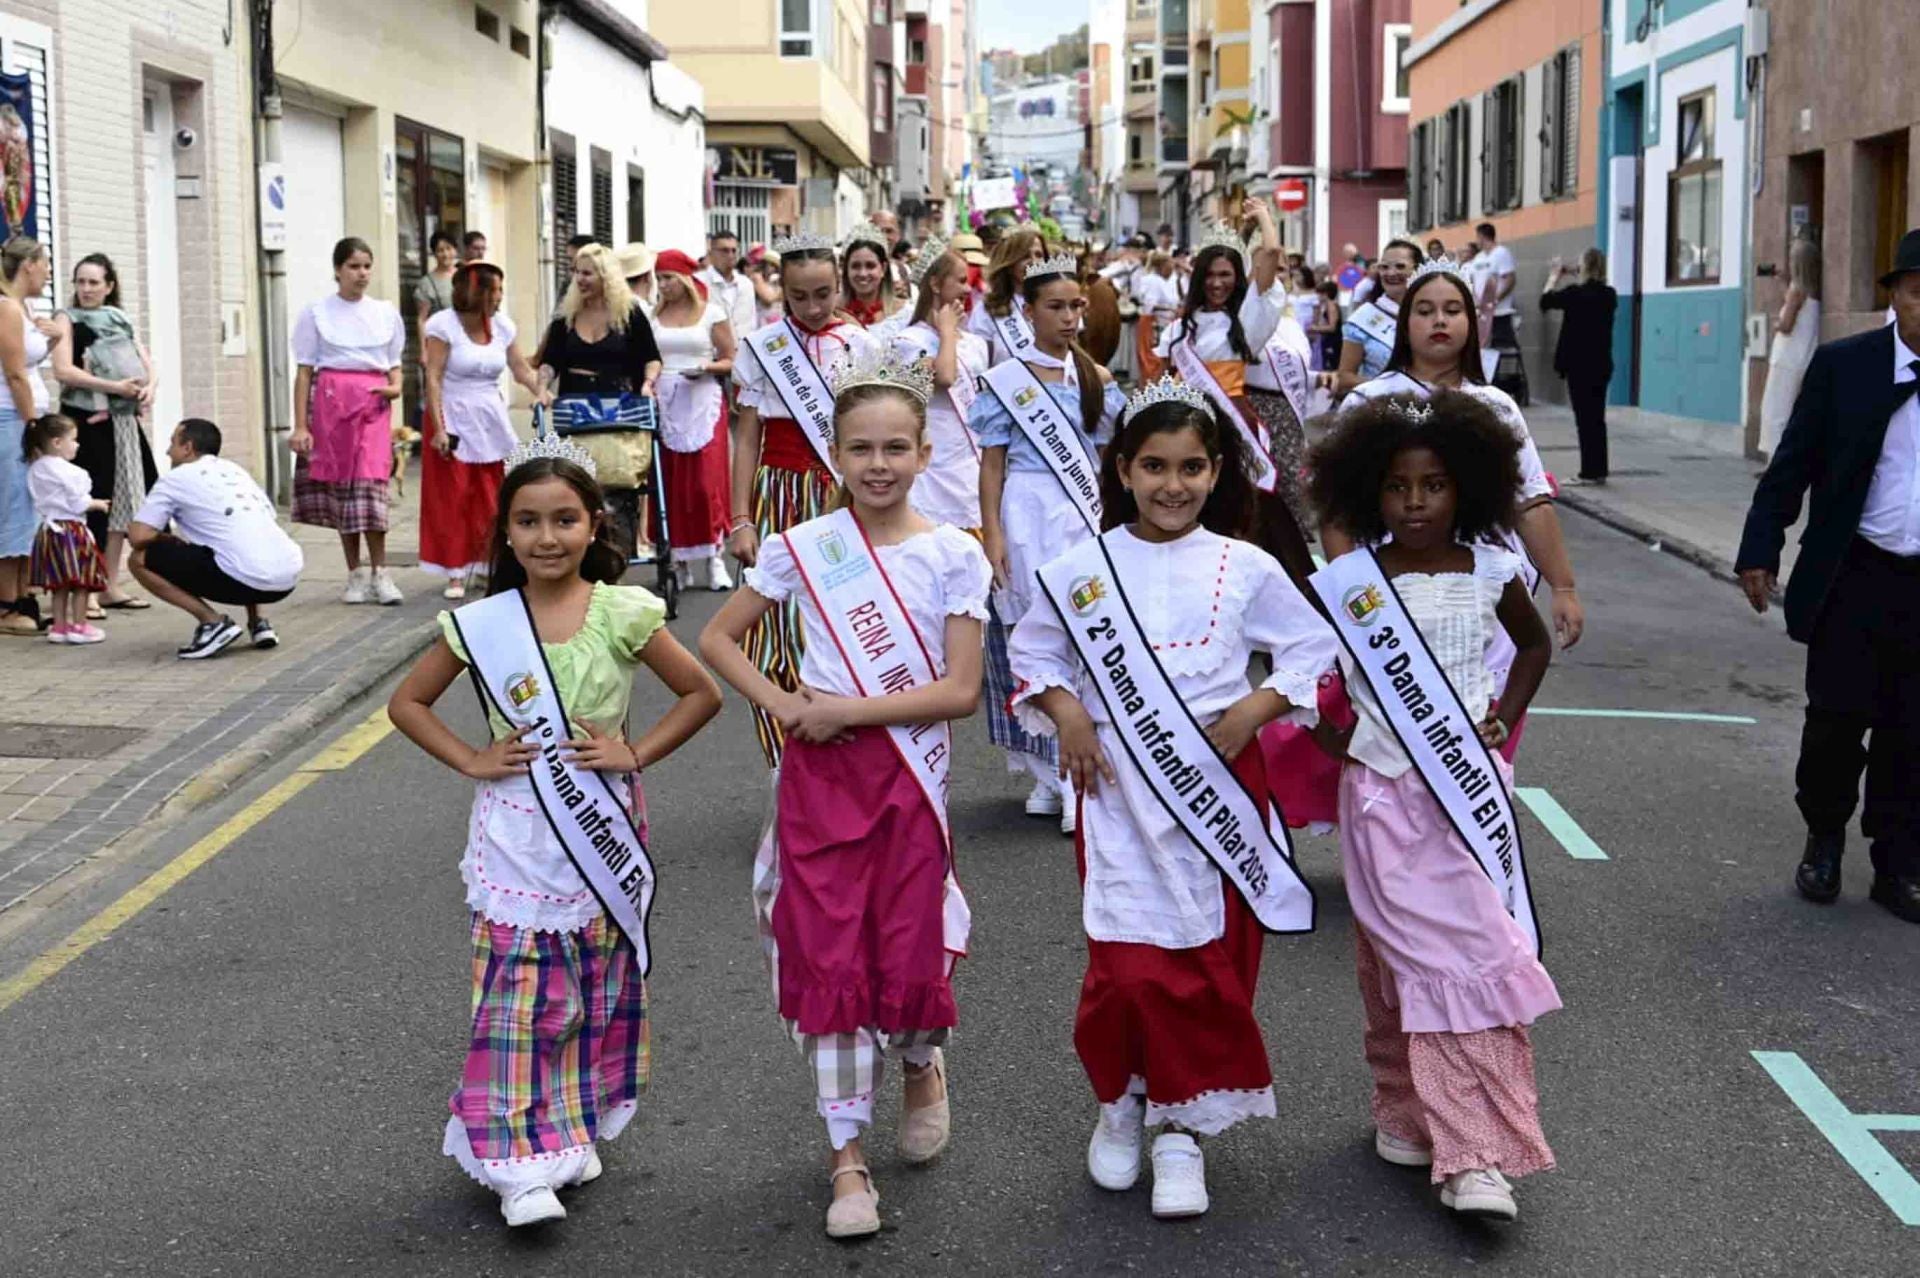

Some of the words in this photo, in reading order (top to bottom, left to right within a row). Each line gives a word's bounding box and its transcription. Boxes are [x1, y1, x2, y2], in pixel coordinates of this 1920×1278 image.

[778, 355, 802, 387] Reina
[795, 385, 812, 401] de
[804, 398, 819, 413] la
[1040, 422, 1073, 464] Dama
[1062, 459, 1095, 501] junior
[1369, 626, 1400, 651] 3º
[846, 600, 896, 662] REINA
[878, 663, 935, 745] INFIL
[924, 743, 946, 773] EL
[1382, 651, 1433, 724] Dama
[1086, 616, 1117, 642] 2º
[1102, 643, 1145, 717] Dama
[1134, 709, 1204, 797] infantil
[1188, 784, 1219, 819] El
[1205, 804, 1247, 860] Pilar
[1238, 846, 1268, 898] 2025
[1423, 715, 1492, 801] infantil
[574, 798, 633, 876] infantil
[1471, 797, 1502, 829] El
[1487, 821, 1513, 880] Pilar
